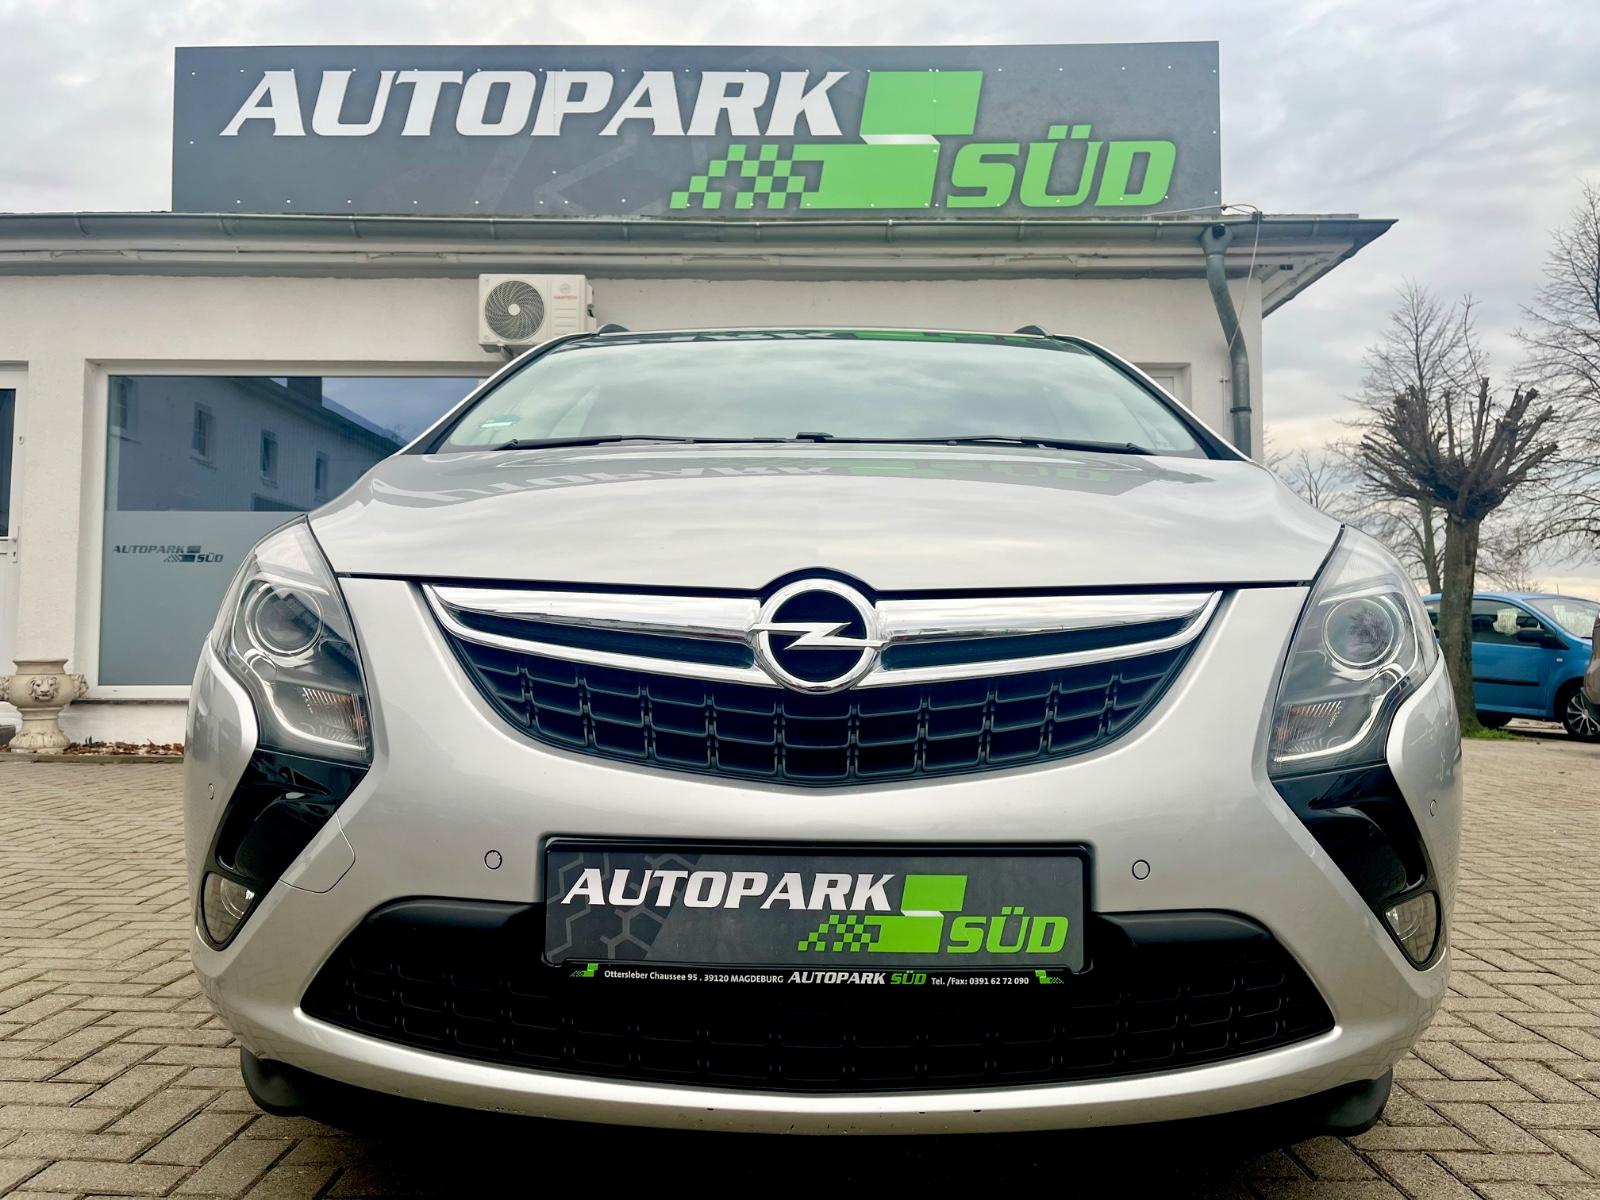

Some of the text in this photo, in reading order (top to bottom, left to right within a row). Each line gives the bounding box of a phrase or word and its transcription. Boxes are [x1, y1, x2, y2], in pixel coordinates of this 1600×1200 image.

[219, 69, 848, 138] AUTOPARK
[945, 123, 1178, 209] SÜD
[113, 545, 185, 554] AUTOPARK
[196, 552, 224, 563] SÜD
[561, 867, 895, 912] AUTOPARK
[946, 906, 1069, 954] SÜD
[604, 970, 648, 980] Ottersleber
[650, 971, 686, 982] Chaussee
[687, 973, 698, 982] 95
[704, 974, 729, 983] 39120
[730, 974, 784, 984] MAGDEBURG
[787, 971, 886, 985] AUTOPARK
[890, 970, 927, 985] SÜD
[931, 977, 946, 986] Tel.
[969, 977, 990, 986] 0391
[990, 976, 1001, 985] 62
[1002, 976, 1013, 985] 72
[1014, 976, 1029, 985] 090
